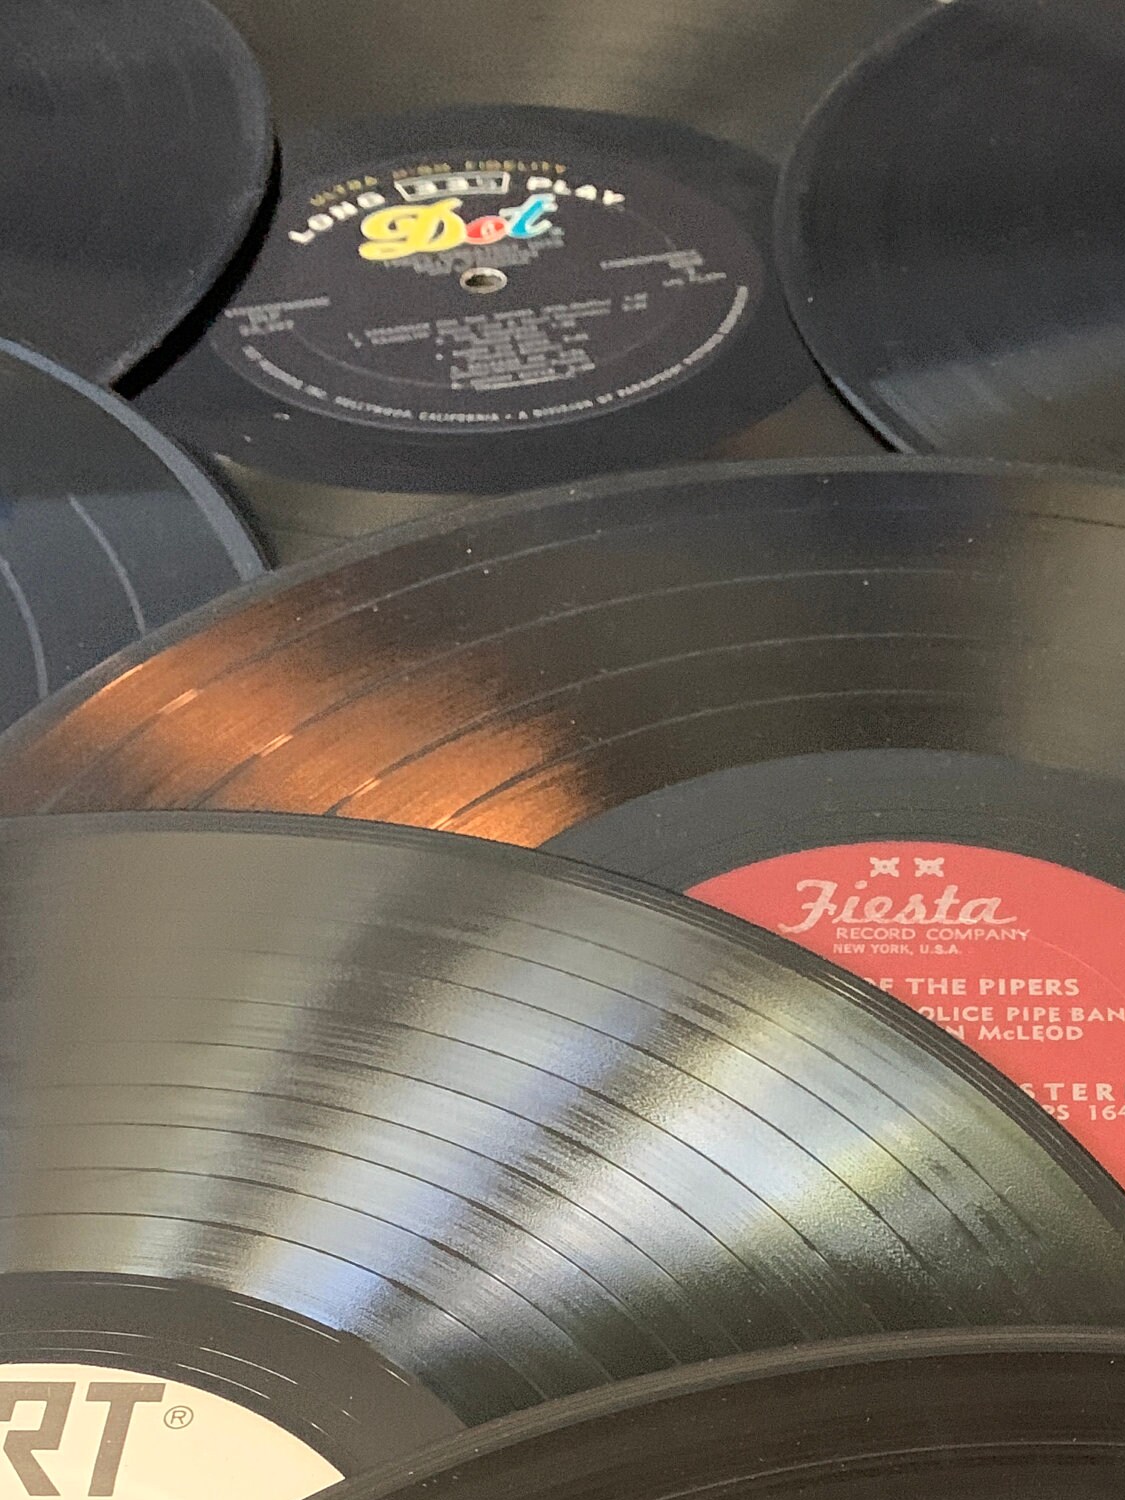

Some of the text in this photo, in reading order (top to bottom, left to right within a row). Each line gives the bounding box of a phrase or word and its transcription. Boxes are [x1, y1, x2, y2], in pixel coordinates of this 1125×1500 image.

[359, 193, 558, 261] Dot
[778, 879, 1018, 934] Fiesta
[836, 927, 1031, 942] RECORD COMPANY
[833, 943, 865, 954] NEW
[871, 943, 913, 956] YORK,
[863, 977, 1080, 996] F THE PIPERS
[1006, 1007, 1061, 1022] PIPE
[978, 1025, 1084, 1041] McLEOD
